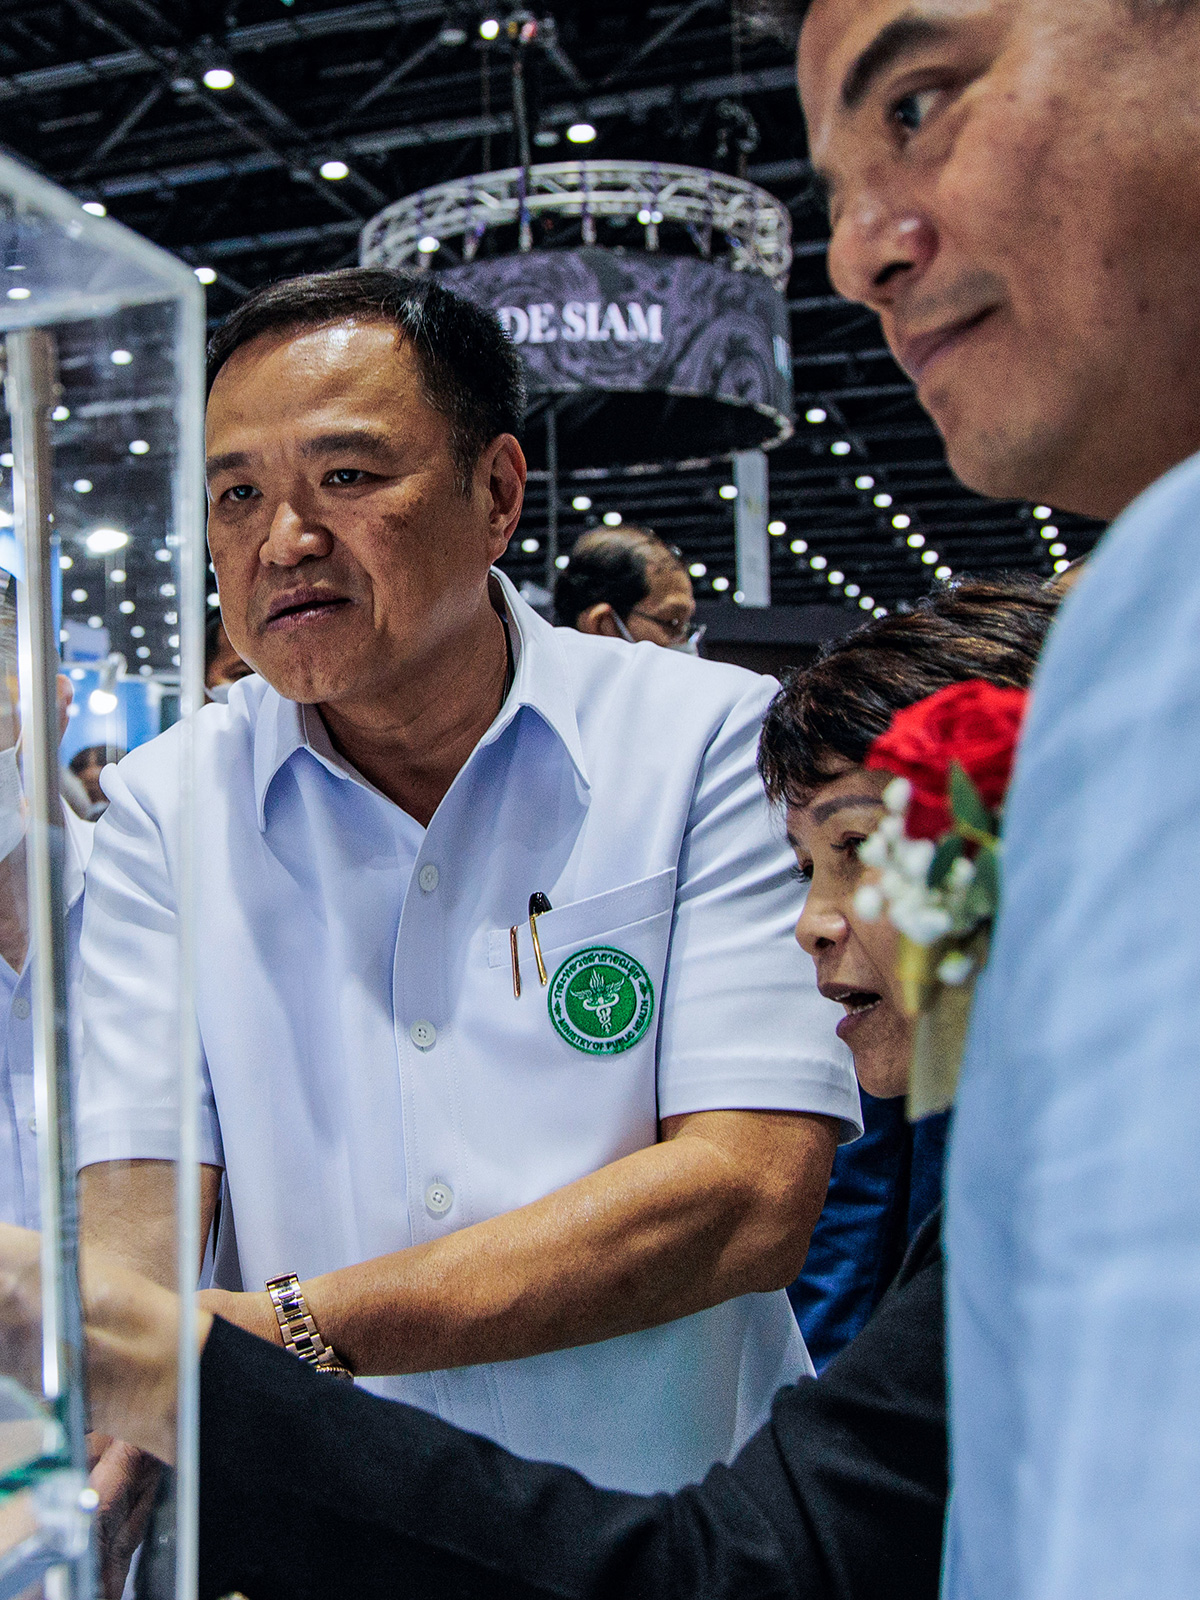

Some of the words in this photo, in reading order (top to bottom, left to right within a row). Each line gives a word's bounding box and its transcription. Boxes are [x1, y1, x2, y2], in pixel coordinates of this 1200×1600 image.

[497, 303, 557, 344] DE
[561, 301, 664, 344] SIAM
[554, 952, 642, 999] กระทรวงสาธารณสุข
[557, 1017, 593, 1049] MINISTRY
[592, 1041, 606, 1051] OF
[606, 1030, 635, 1050] PUBLIC
[632, 999, 649, 1033] HEALTH
